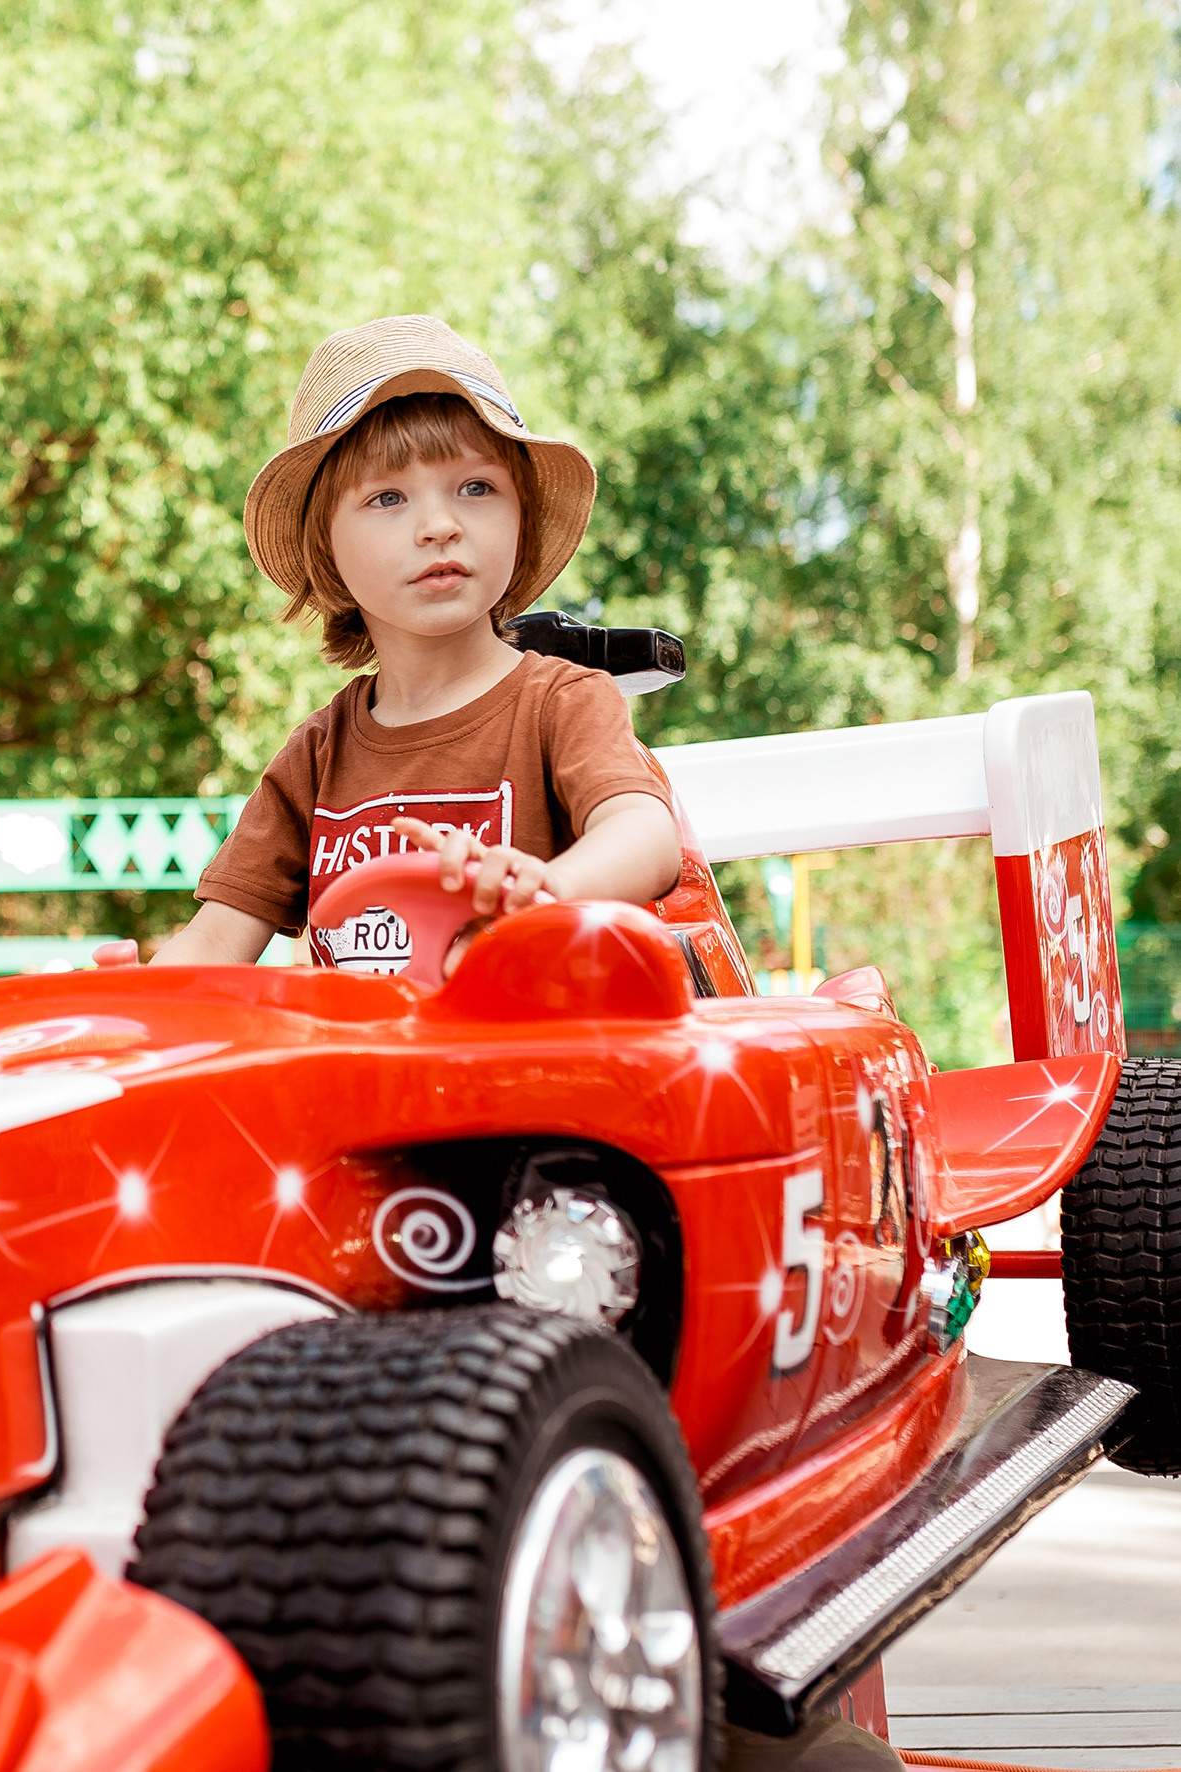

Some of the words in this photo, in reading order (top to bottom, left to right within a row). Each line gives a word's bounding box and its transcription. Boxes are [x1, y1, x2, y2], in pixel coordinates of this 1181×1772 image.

[312, 820, 491, 877] HIST
[1066, 893, 1092, 1025] 5
[772, 1168, 825, 1372] 5
